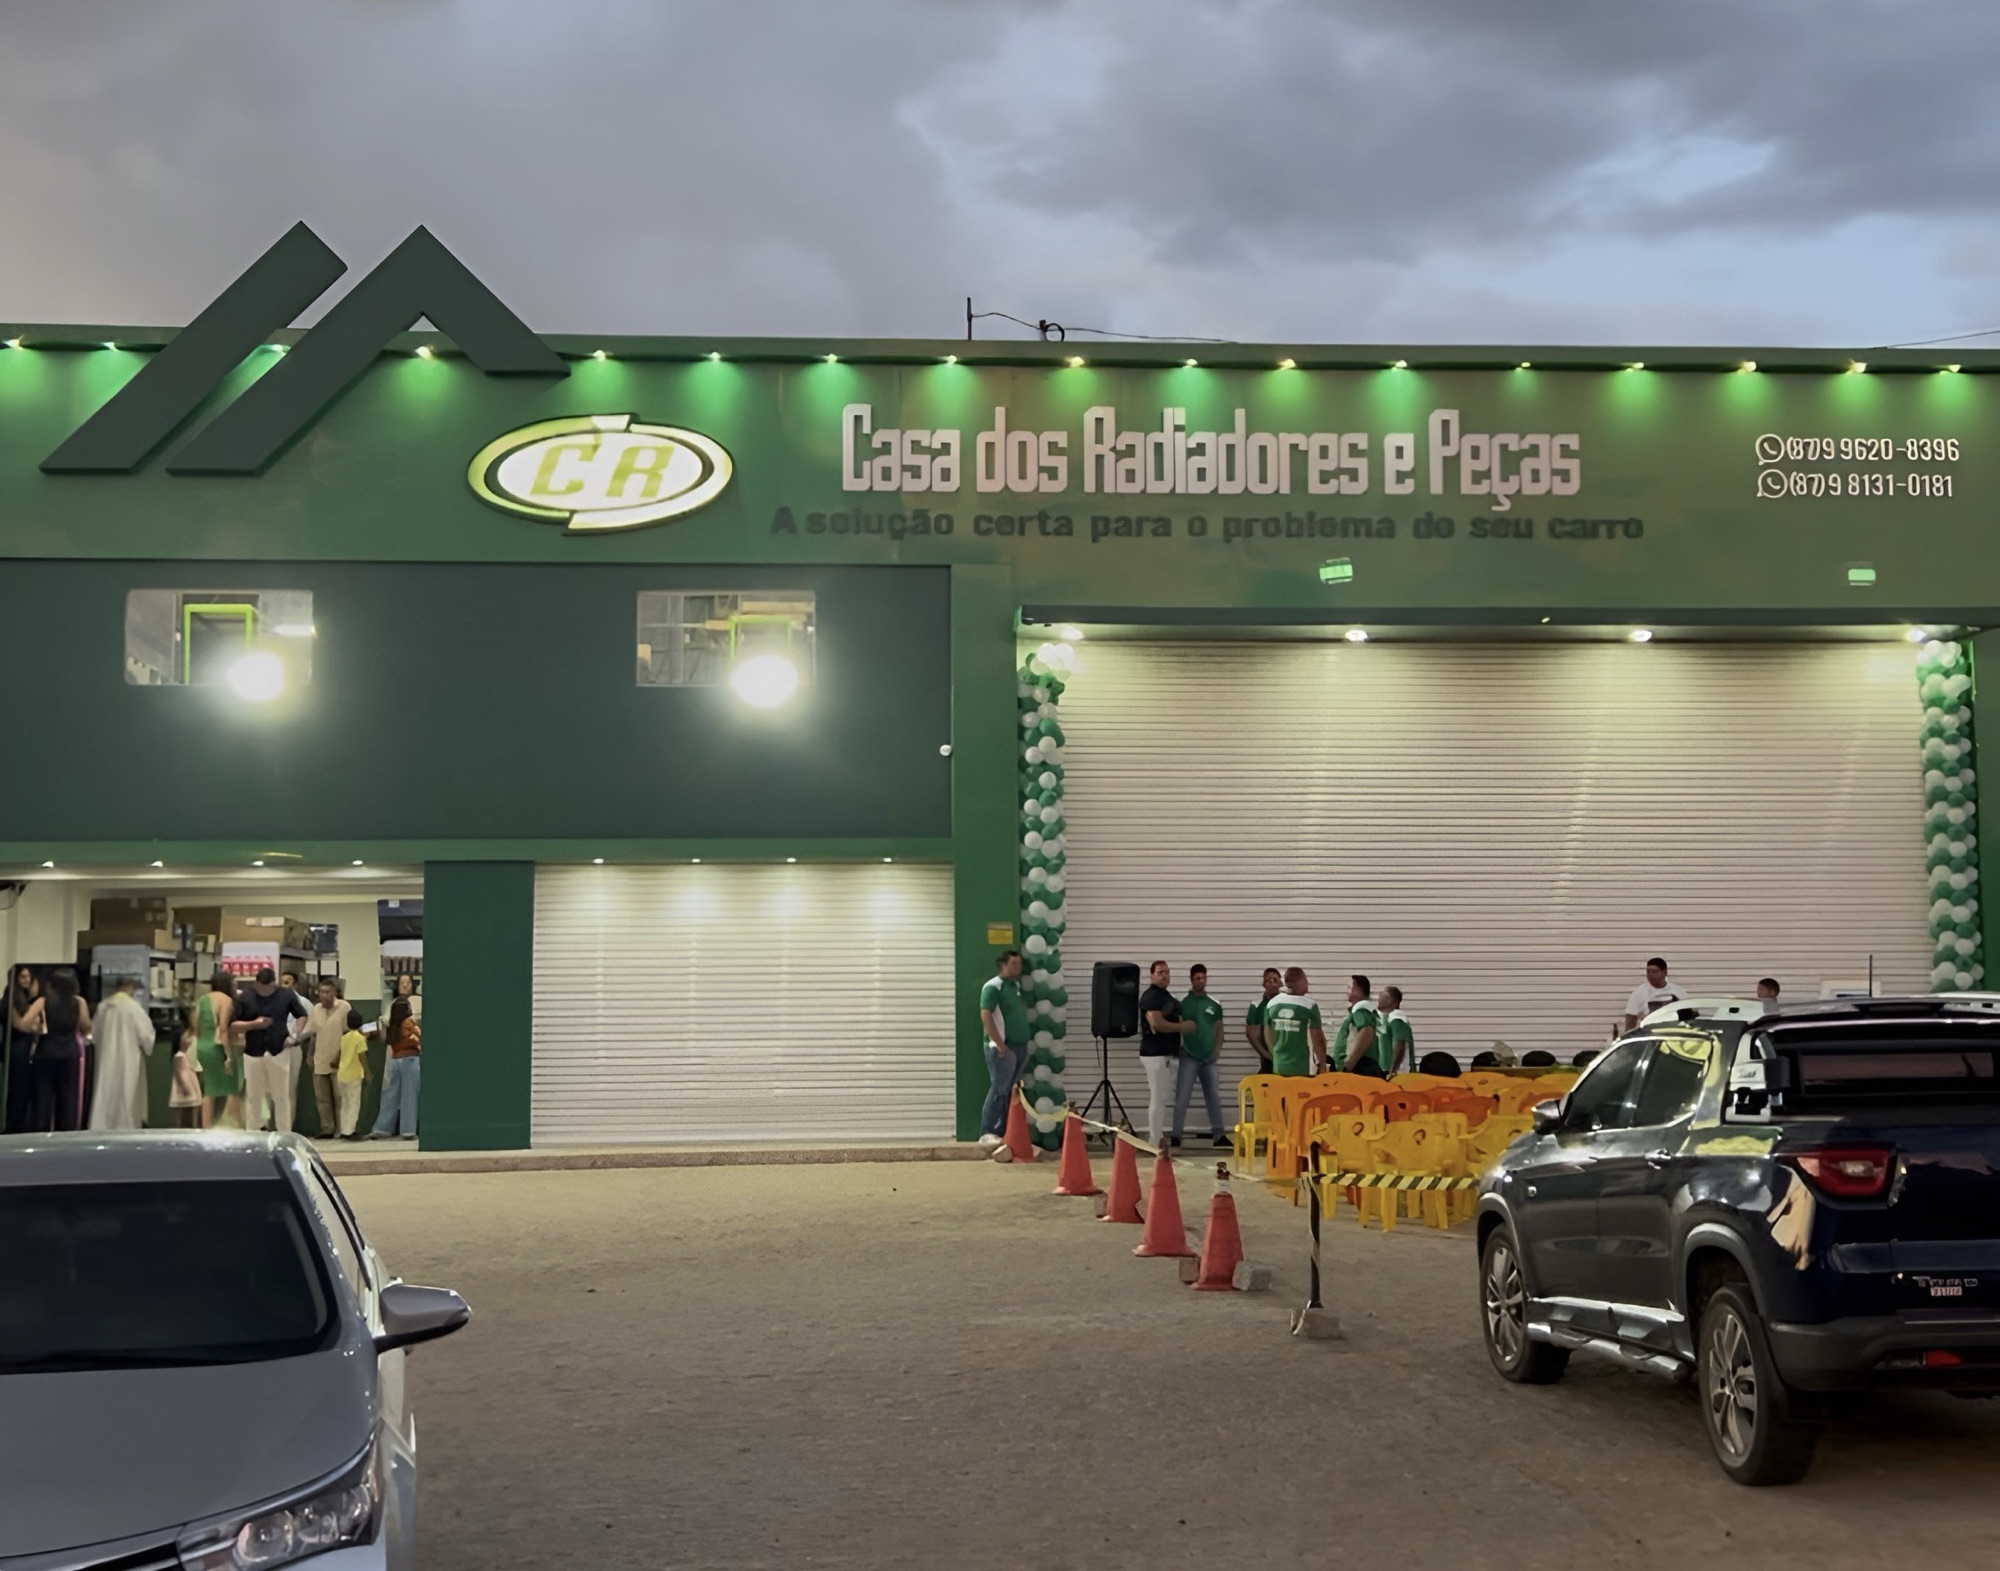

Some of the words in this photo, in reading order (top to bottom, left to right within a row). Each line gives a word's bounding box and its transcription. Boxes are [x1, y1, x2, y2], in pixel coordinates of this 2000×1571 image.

[528, 443, 675, 498] CR
[842, 403, 961, 492] Casa
[976, 406, 1068, 493] dos
[1083, 406, 1369, 495] Radiadores
[1383, 432, 1416, 495] e
[1428, 408, 1581, 512] Peças
[770, 506, 798, 535] A
[805, 507, 956, 541] solução
[1090, 514, 1173, 544] para
[1187, 514, 1209, 538] o
[1412, 510, 1456, 540] do
[1468, 516, 1534, 540] seu
[1547, 516, 1645, 540] carro
